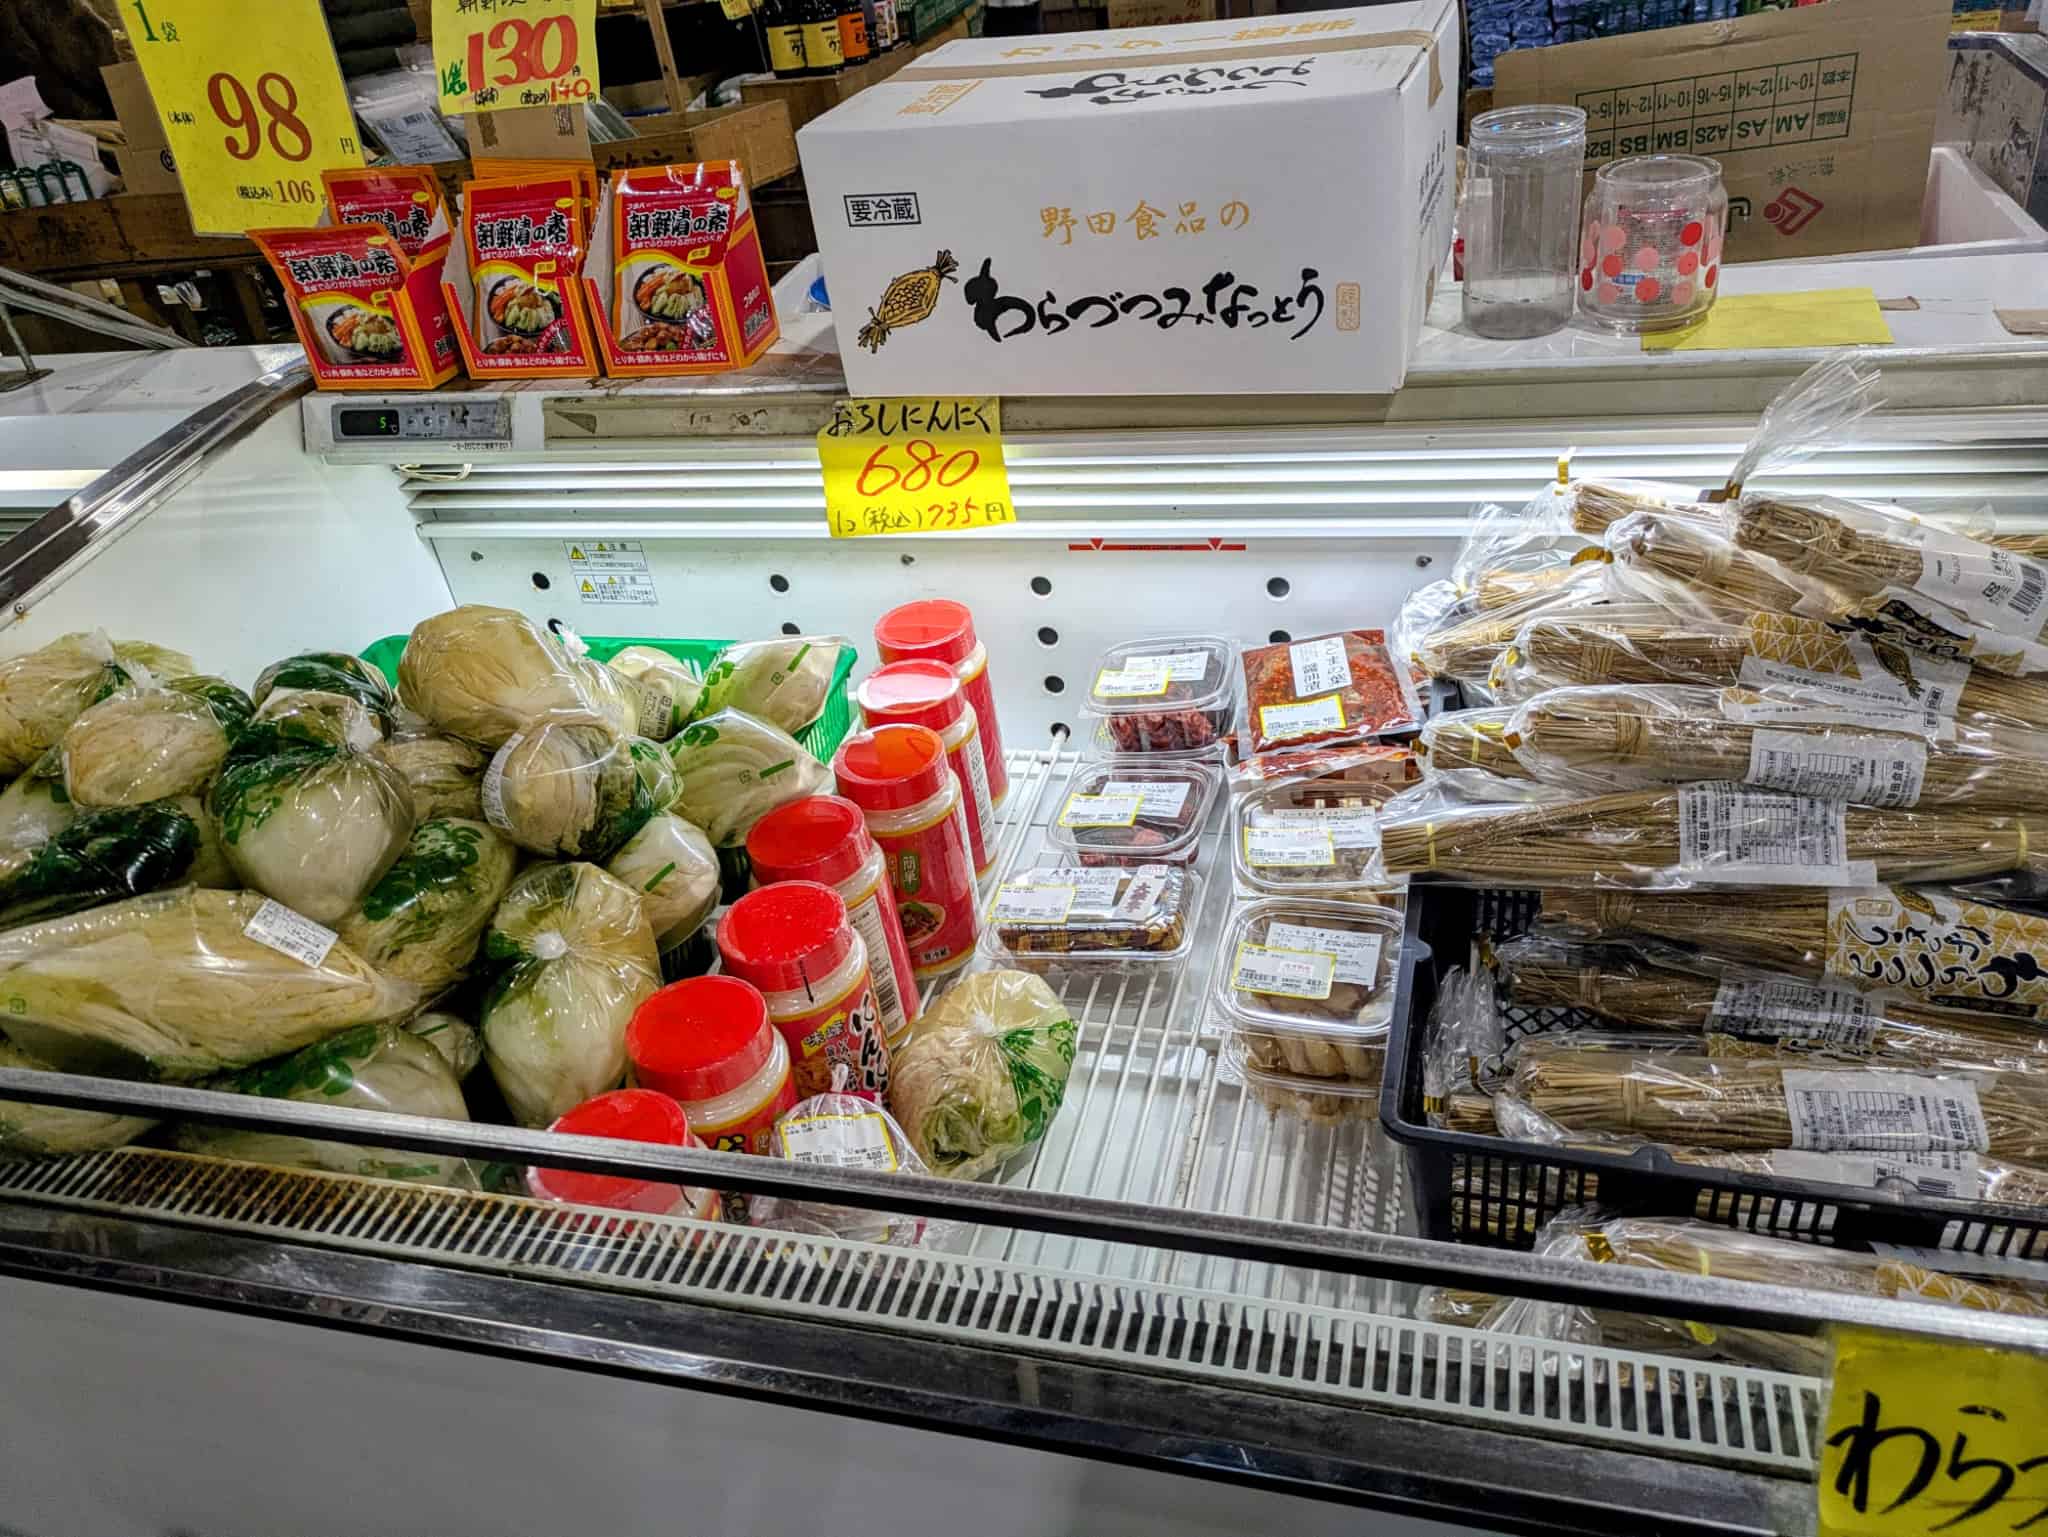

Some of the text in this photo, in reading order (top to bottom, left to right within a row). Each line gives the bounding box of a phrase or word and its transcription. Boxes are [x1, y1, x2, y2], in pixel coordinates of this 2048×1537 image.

[467, 14, 578, 91] 130
[207, 72, 313, 162] 98
[1580, 101, 1613, 122] 15~1
[1775, 112, 1810, 135] AM
[1656, 128, 1689, 151] BM
[1695, 124, 1729, 146] A2S
[1736, 118, 1769, 141] AS
[1619, 134, 1649, 155] BS
[275, 180, 315, 205] 106
[851, 196, 916, 224] 要冷蔵
[1040, 199, 1251, 246] 野田食品の
[964, 256, 1326, 344] わらづつみなっとう
[827, 399, 991, 438] おろしにんにく
[855, 438, 980, 498] 680
